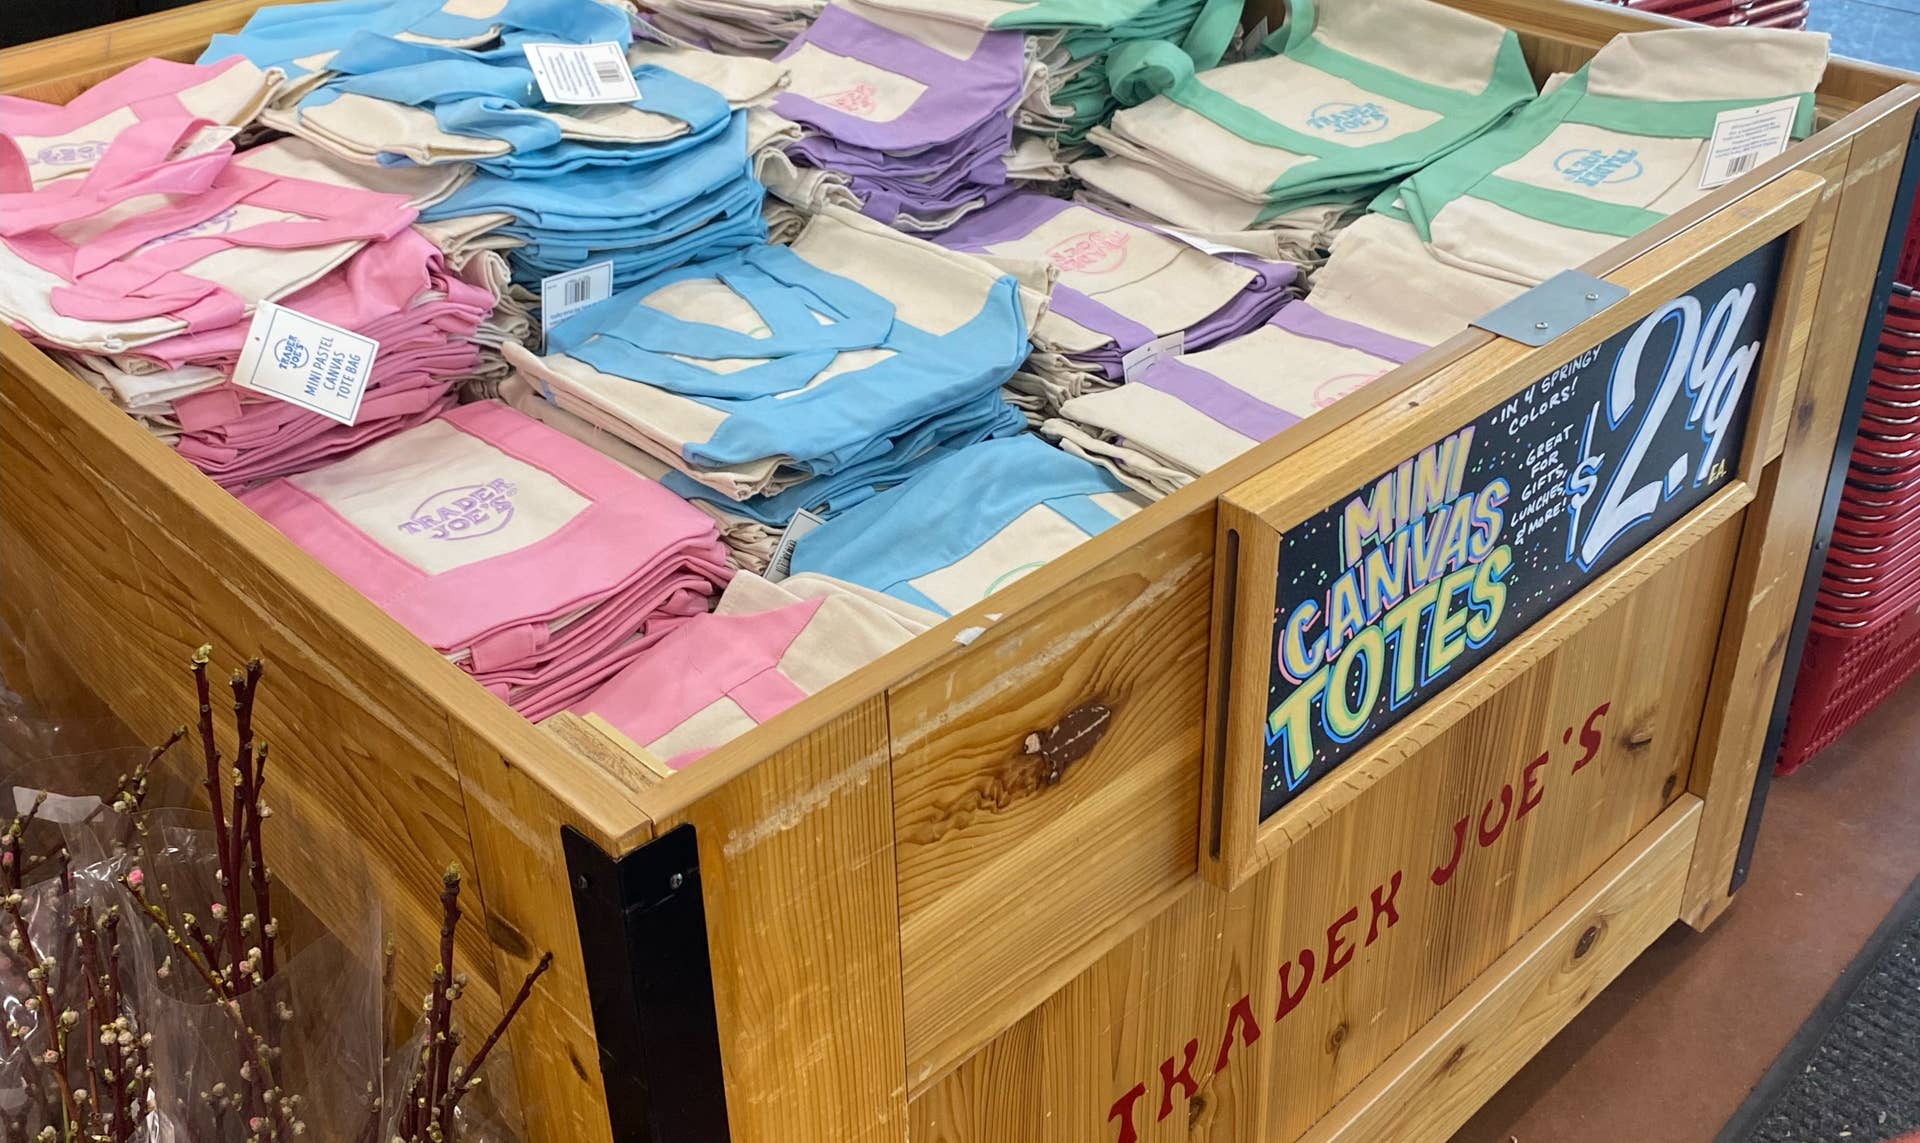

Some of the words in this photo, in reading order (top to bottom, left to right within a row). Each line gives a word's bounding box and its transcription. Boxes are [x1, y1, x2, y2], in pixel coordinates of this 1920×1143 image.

[278, 335, 298, 369] TRADER
[290, 343, 304, 369] JOE'S
[304, 370, 321, 396] MINI
[313, 336, 334, 371] PASTEL
[323, 352, 346, 391] CANVAS
[345, 354, 361, 375] BAG
[336, 374, 355, 399] TOTE
[1500, 399, 1519, 423] IN
[1525, 385, 1536, 404] 4
[1541, 344, 1602, 393] SPRINGY
[1508, 376, 1579, 436] COLORS!
[1526, 424, 1574, 466] GREAT
[1567, 282, 1761, 568] $2.99
[1521, 463, 1568, 501] GIFTS,
[1530, 450, 1559, 478] FOR
[398, 478, 514, 534] TRADER
[430, 495, 512, 539] JOE'S
[1341, 426, 1476, 570] MINI
[1510, 481, 1567, 527] LUNCHES,
[1514, 522, 1527, 545] &
[1527, 497, 1567, 535] MORE!
[1279, 477, 1511, 684] CANVAS
[1266, 544, 1514, 790] TOTES
[1431, 701, 1611, 886] JOE'S
